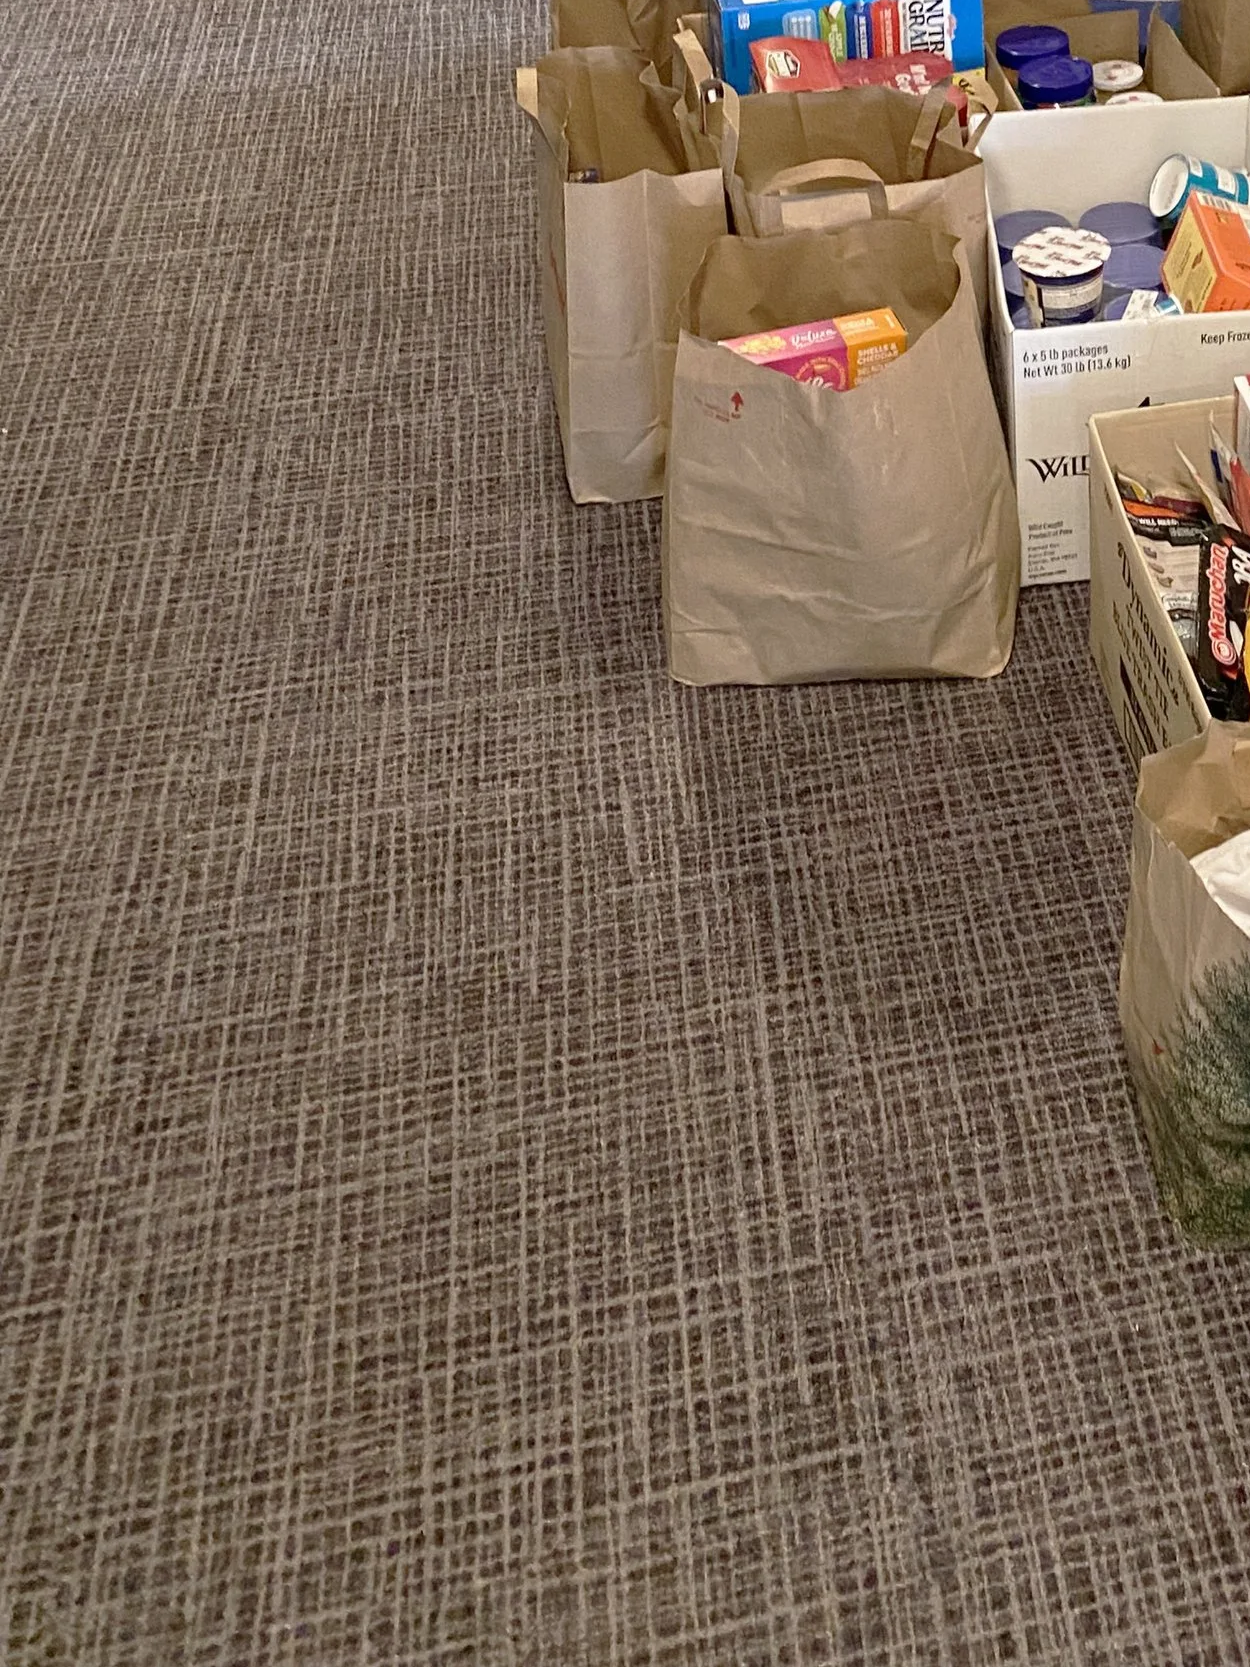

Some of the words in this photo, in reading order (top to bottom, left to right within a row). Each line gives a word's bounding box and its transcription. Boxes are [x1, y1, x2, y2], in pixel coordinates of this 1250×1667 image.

[1201, 334, 1225, 345] Keep
[1023, 351, 1029, 363] 6
[1032, 352, 1038, 362] x
[1040, 350, 1046, 362] 5
[1049, 348, 1058, 360] lb
[1062, 344, 1109, 360] packages
[1023, 367, 1041, 379] Net
[1043, 365, 1058, 377] Wt
[1061, 362, 1072, 375] 30
[1075, 361, 1085, 373] lb
[1088, 357, 1112, 373] (13.6
[1115, 354, 1131, 370] kg)
[1206, 544, 1229, 639] Maruchan
